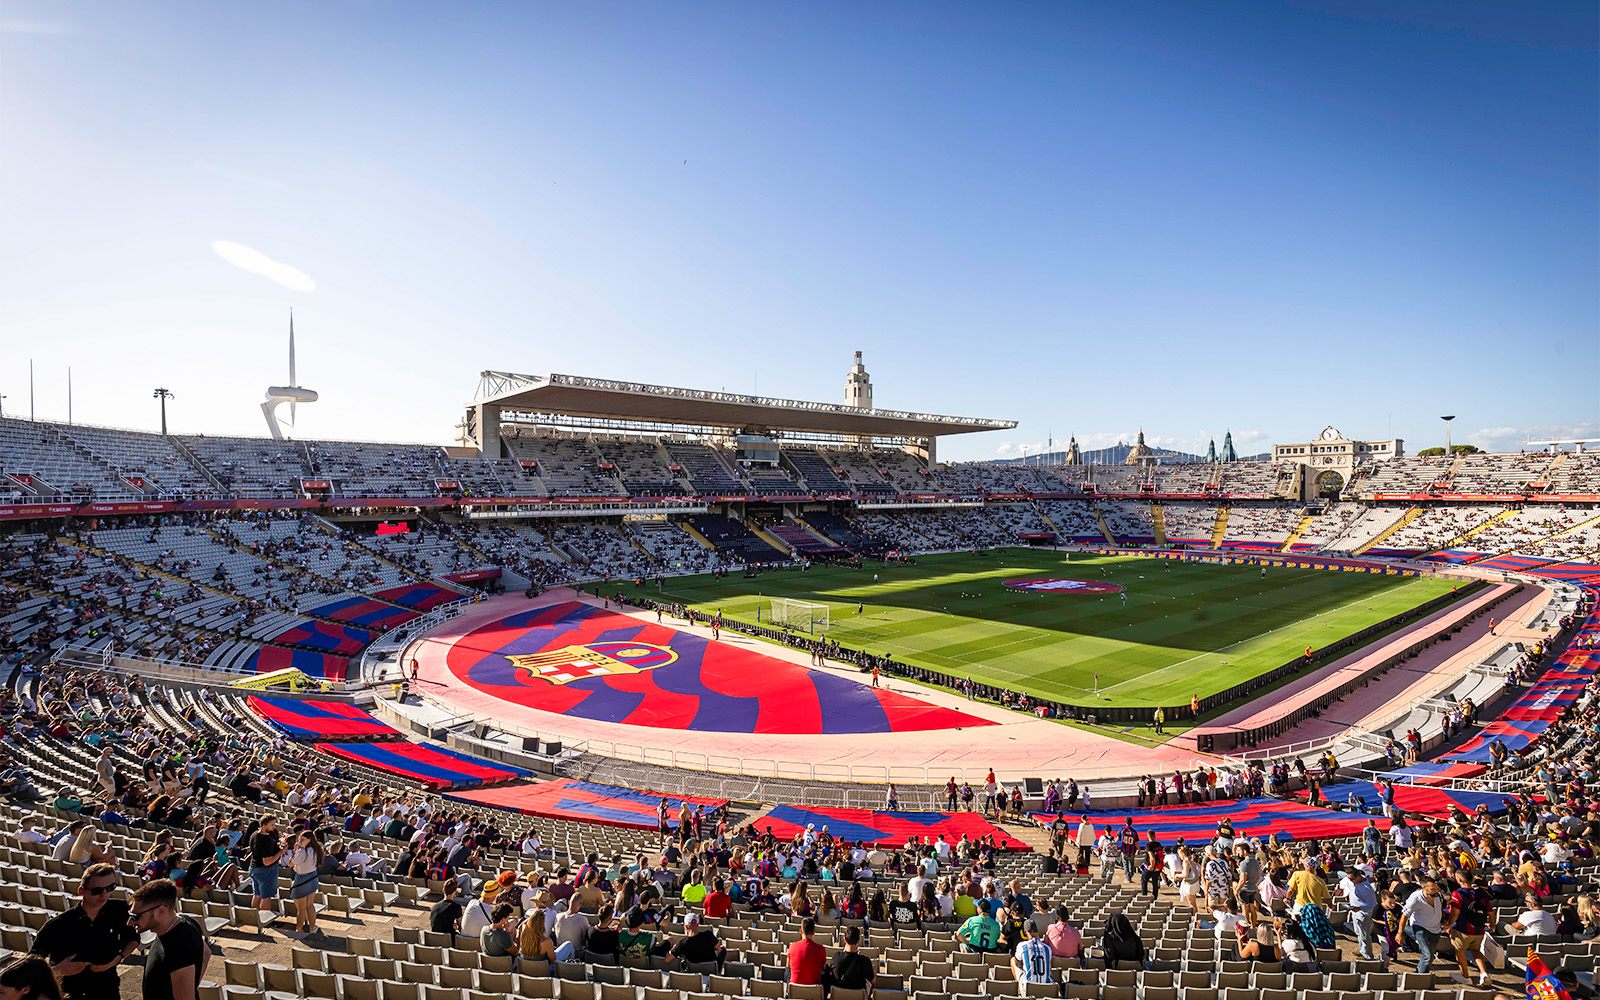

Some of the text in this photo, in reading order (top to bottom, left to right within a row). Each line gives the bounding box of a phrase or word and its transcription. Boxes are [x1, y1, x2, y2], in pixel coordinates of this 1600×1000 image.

[749, 882, 757, 897] 9
[979, 932, 991, 949] 6
[1031, 955, 1046, 976] 10
